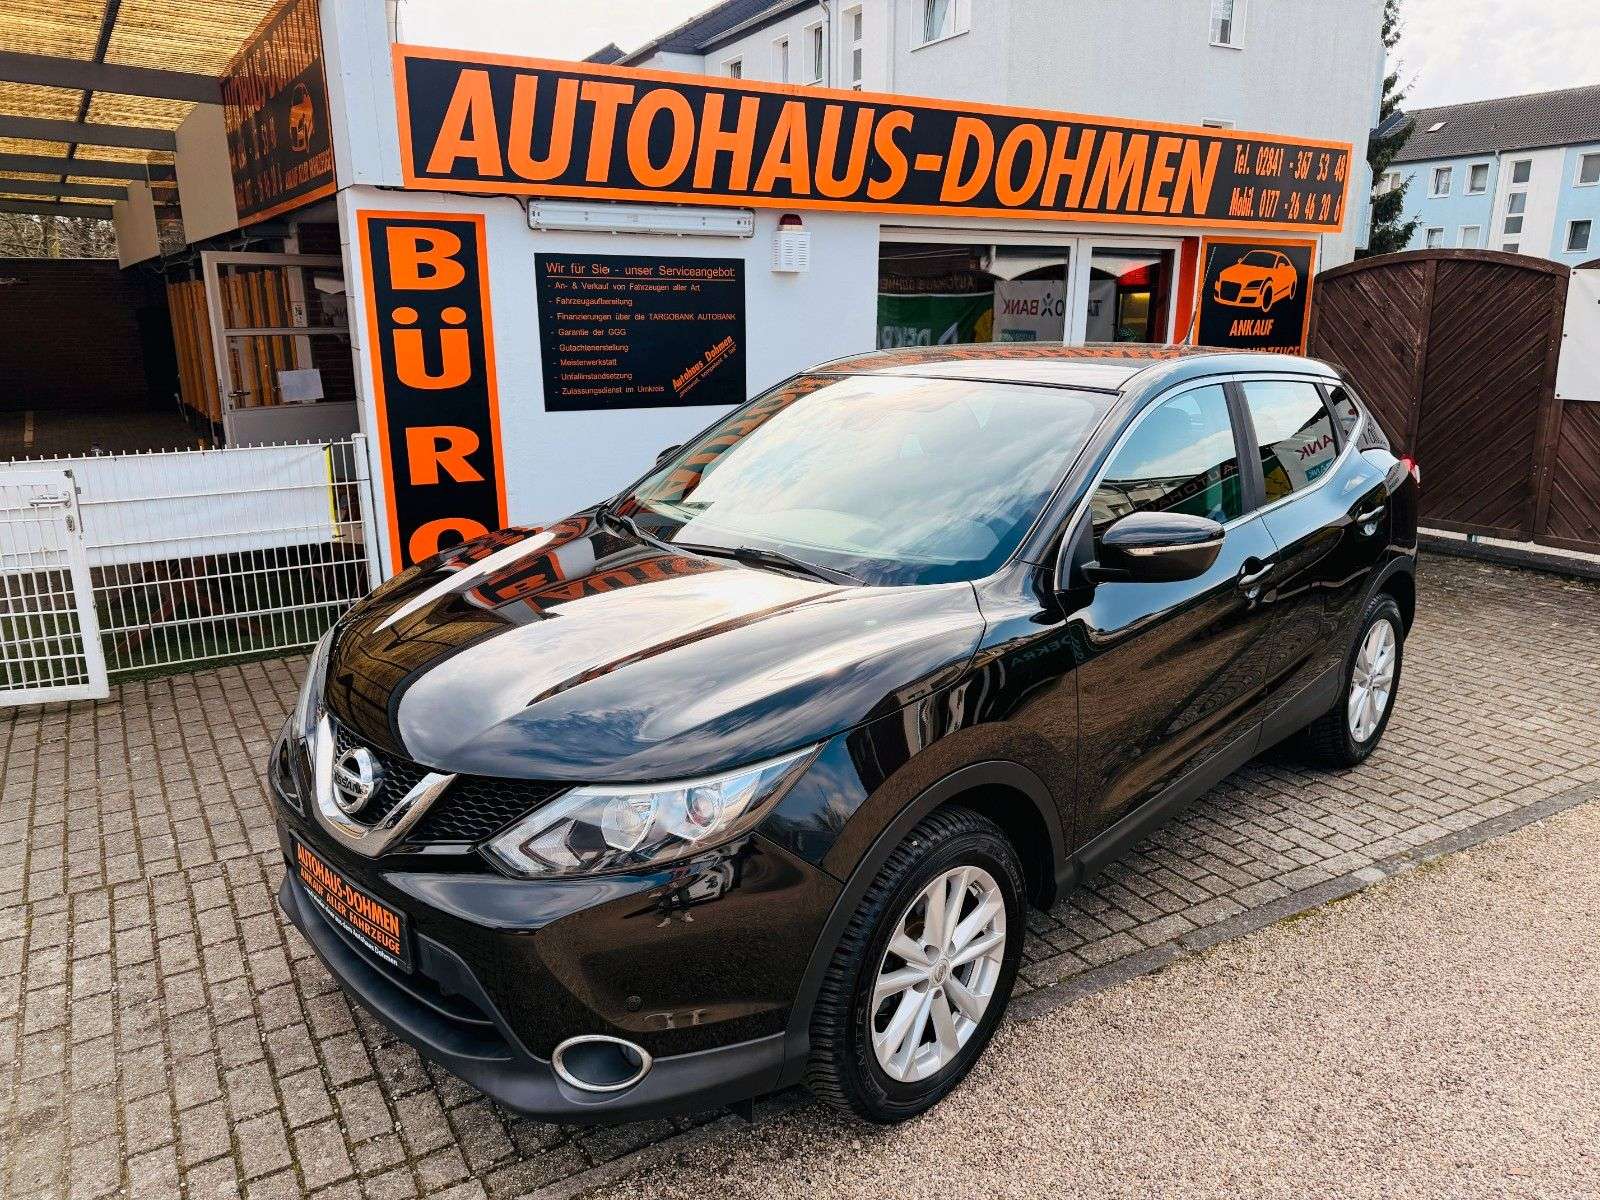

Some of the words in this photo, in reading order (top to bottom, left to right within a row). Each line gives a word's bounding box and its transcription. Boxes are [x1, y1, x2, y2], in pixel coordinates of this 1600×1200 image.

[426, 68, 1222, 216] AUTOHAUS-DOHMEN
[1234, 144, 1250, 174] Tel.
[1255, 146, 1284, 176] 02841
[1316, 153, 1330, 181] 53
[1333, 154, 1347, 182] 48
[1228, 186, 1255, 217] Mobil.
[1259, 189, 1281, 218] 0177
[1304, 192, 1317, 221] 46
[1318, 193, 1331, 221] 20
[546, 262, 565, 274] Wir
[570, 262, 585, 275] für
[591, 263, 609, 275] Sie
[624, 266, 653, 276] unser
[658, 265, 736, 279] Serviceangebot:
[580, 281, 609, 290] Verkauf
[629, 282, 669, 293] Fahrzeugen
[555, 296, 633, 307] Fahrzeugaufbereitung
[557, 312, 612, 322] Finanzierungen
[615, 312, 631, 321] über
[634, 312, 645, 321] die
[649, 312, 694, 321] TARGOBANK
[697, 312, 736, 321] AUTOBANK
[558, 328, 589, 336] Garantie
[592, 328, 604, 336] der
[1228, 319, 1274, 337] ANKAUF
[559, 343, 630, 353] Gutachtenerstellung
[560, 359, 617, 367] Meisterwerkstatt
[672, 361, 704, 391] Autohaus
[704, 335, 733, 363] Dohmen
[561, 372, 633, 381] Unfallinstandsetzung
[562, 386, 622, 396] Zulassungsdienst
[637, 385, 664, 393] Umkreis
[297, 842, 400, 937] AUTOHAUS-DOHMEN
[300, 867, 324, 896] ANKAUF
[326, 892, 348, 918] ALLER
[349, 911, 400, 955] FAHRZEUGE
[374, 947, 399, 967] Dohmen
